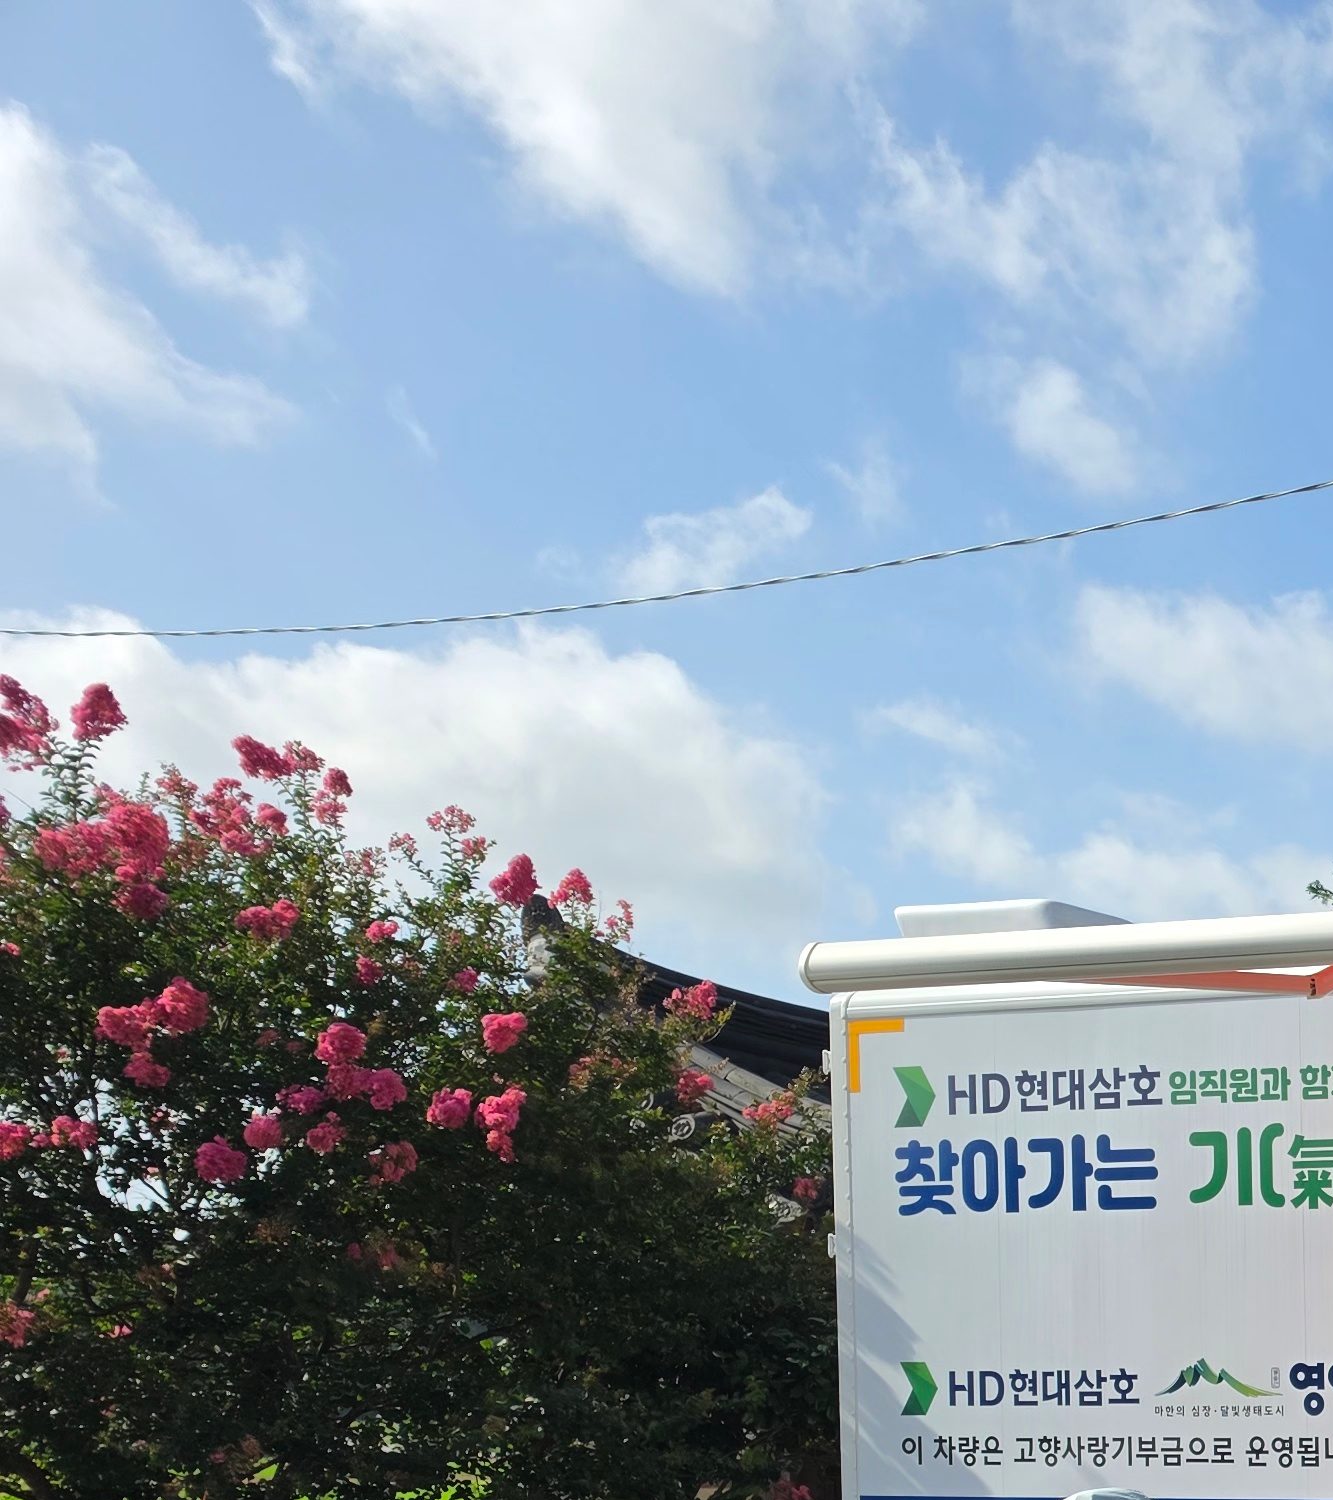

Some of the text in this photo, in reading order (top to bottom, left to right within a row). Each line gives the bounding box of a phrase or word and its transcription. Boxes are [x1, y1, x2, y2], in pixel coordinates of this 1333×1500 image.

[1168, 1067, 1291, 1104] 임직원과
[894, 1133, 1159, 1216] 찾아가는
[1154, 1405, 1186, 1418] 마한의
[900, 1436, 923, 1466] 이
[932, 1435, 1004, 1467] 차량은
[1013, 1436, 1235, 1467] 고향사랑기부금으로
